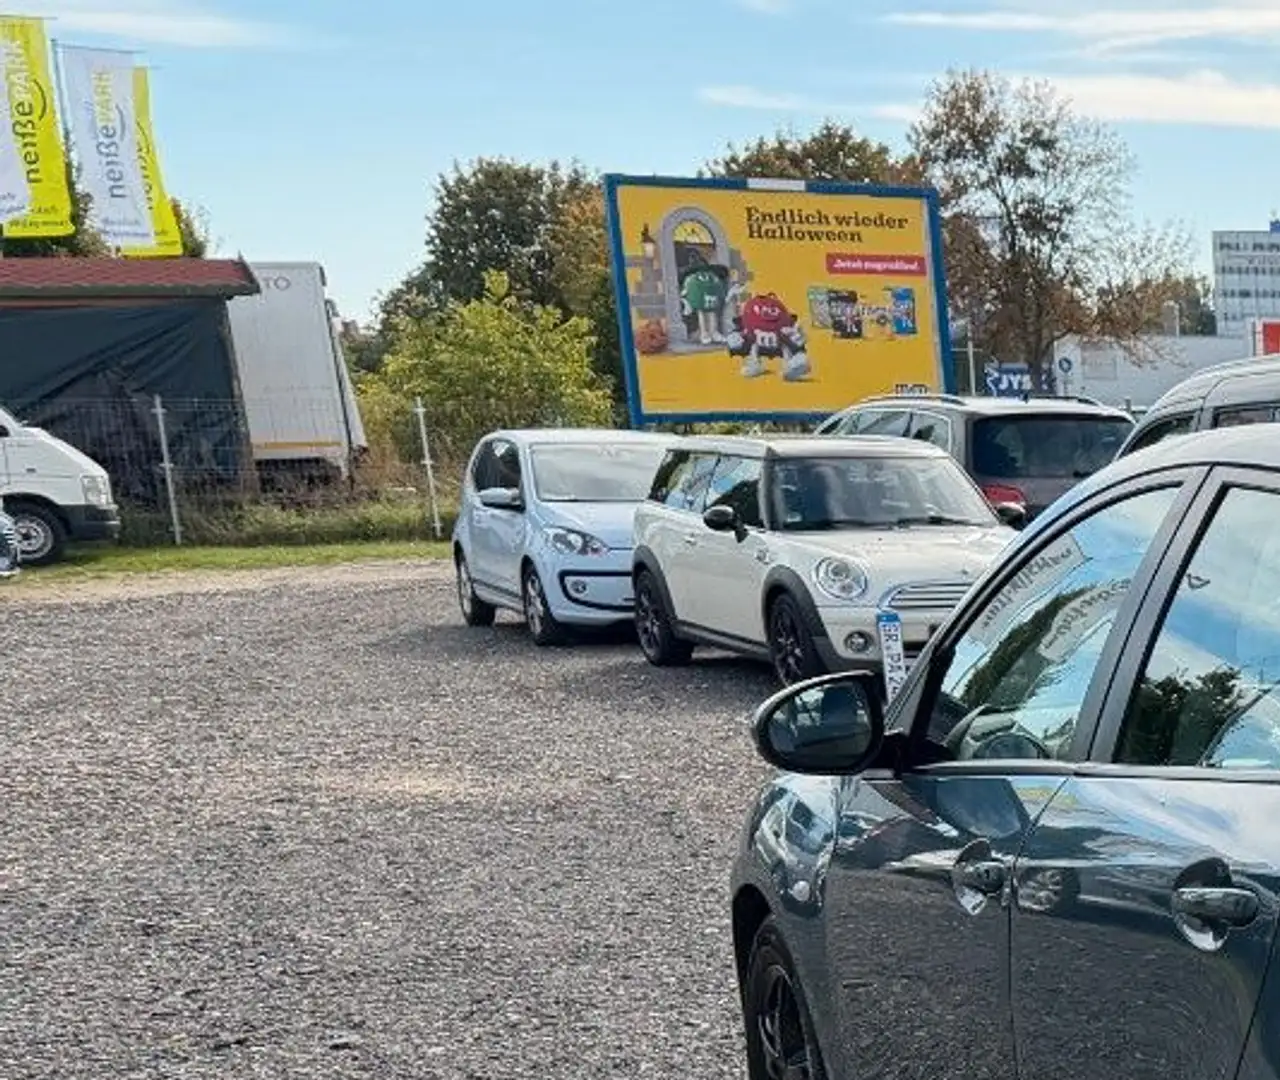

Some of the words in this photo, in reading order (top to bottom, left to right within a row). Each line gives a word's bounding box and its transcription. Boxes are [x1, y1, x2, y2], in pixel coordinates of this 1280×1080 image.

[745, 206, 830, 226] Endlich
[835, 212, 909, 229] wieder
[747, 223, 863, 243] Halloween
